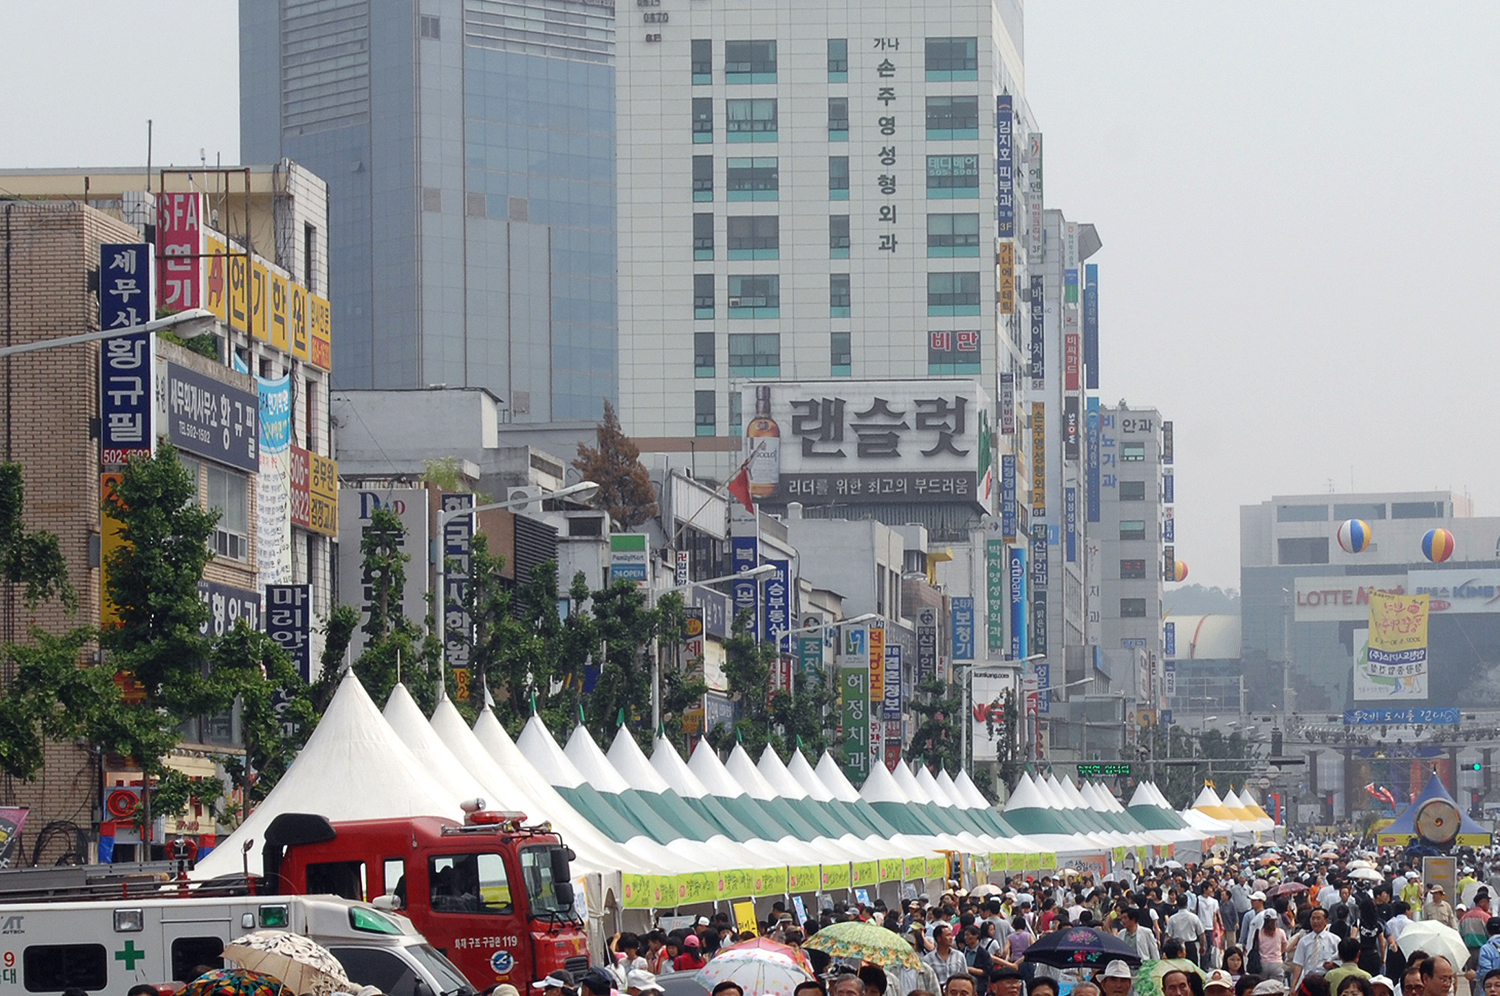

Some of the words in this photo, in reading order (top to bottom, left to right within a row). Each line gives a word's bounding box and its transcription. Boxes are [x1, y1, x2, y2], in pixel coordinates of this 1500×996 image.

[874, 38, 900, 50] 가나
[877, 58, 898, 253] 손주영성형외과
[1000, 121, 1011, 161] 김지호
[1000, 166, 1012, 207] 피부과
[159, 194, 198, 232] SFA
[1000, 223, 1012, 231] 3F
[165, 244, 192, 307] 연기
[231, 255, 306, 351] 연기학원
[931, 331, 978, 351] 비만
[1031, 287, 1044, 375] 바른이치과
[1066, 336, 1078, 374] 비씨카드
[107, 337, 147, 443] 황규필
[170, 377, 218, 429] 세무회계사무소
[789, 396, 971, 458] 랜슬럿
[1067, 413, 1076, 445] SHOW
[1122, 418, 1153, 434] 안과
[1033, 410, 1046, 505] 손주영성형외과
[1101, 414, 1117, 489] 비뇨기과
[313, 457, 335, 492] 공무원
[789, 480, 828, 495] 리더를
[836, 479, 862, 495] 위한
[868, 479, 907, 494] 최고의
[914, 478, 968, 494] 부드러움
[1066, 492, 1075, 533] 삼성생명
[613, 569, 625, 579] 24
[626, 568, 645, 579] OPEN
[1011, 558, 1025, 603] citibank
[1034, 541, 1048, 586] 산부인과
[1089, 585, 1100, 623] 치과
[1297, 589, 1354, 607] LOTTE
[955, 611, 973, 656] 보청기
[847, 674, 867, 772] 허정치과
[455, 939, 467, 949] 화재
[469, 937, 481, 948] 구조
[503, 935, 518, 947] 119
